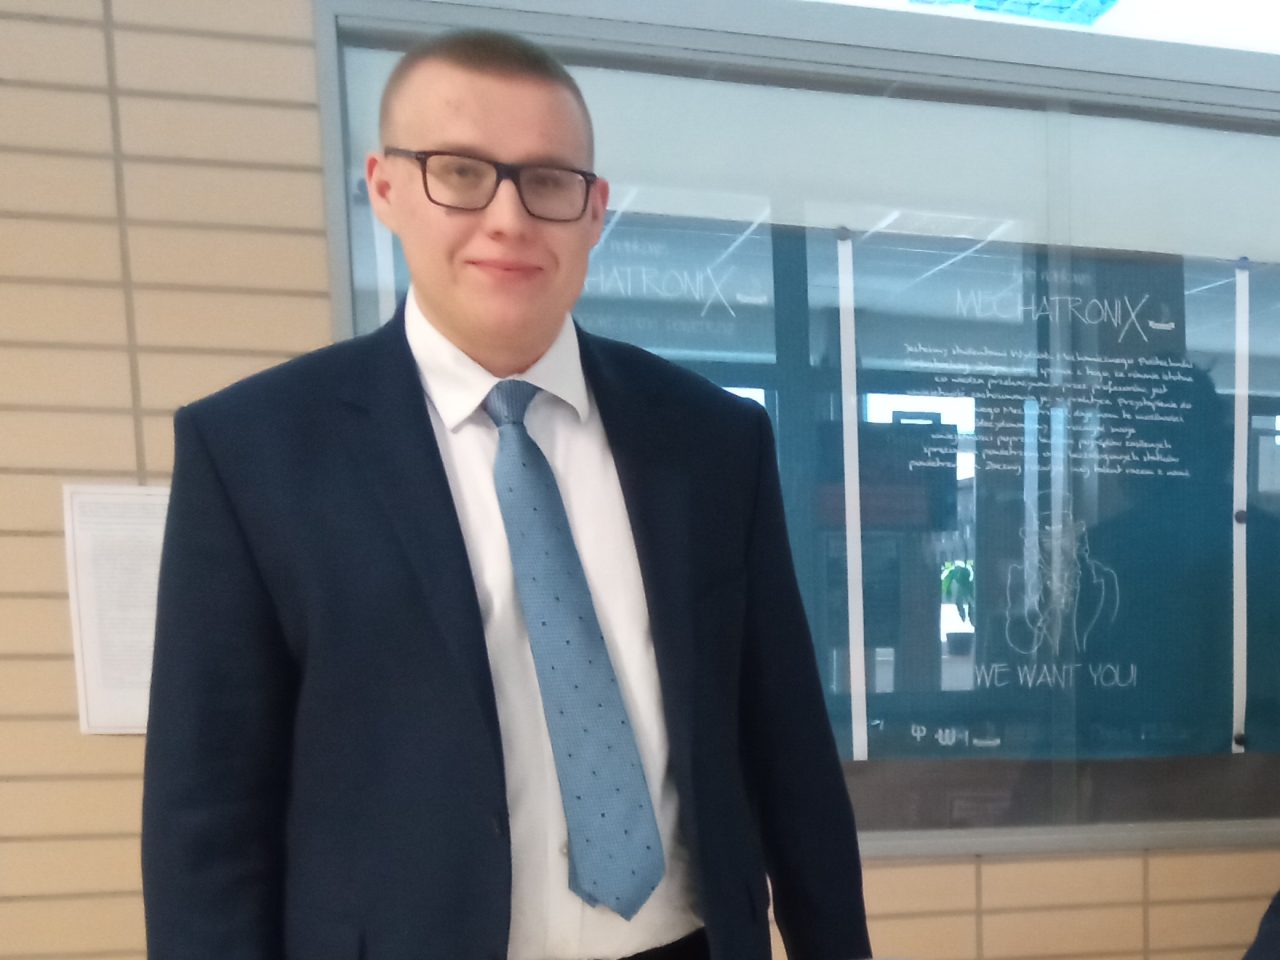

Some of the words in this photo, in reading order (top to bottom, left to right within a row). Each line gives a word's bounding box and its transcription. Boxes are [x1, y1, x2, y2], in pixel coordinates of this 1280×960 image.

[976, 664, 1010, 687] WE
[1016, 663, 1081, 688] WANT
[1088, 663, 1137, 687] YOU!
